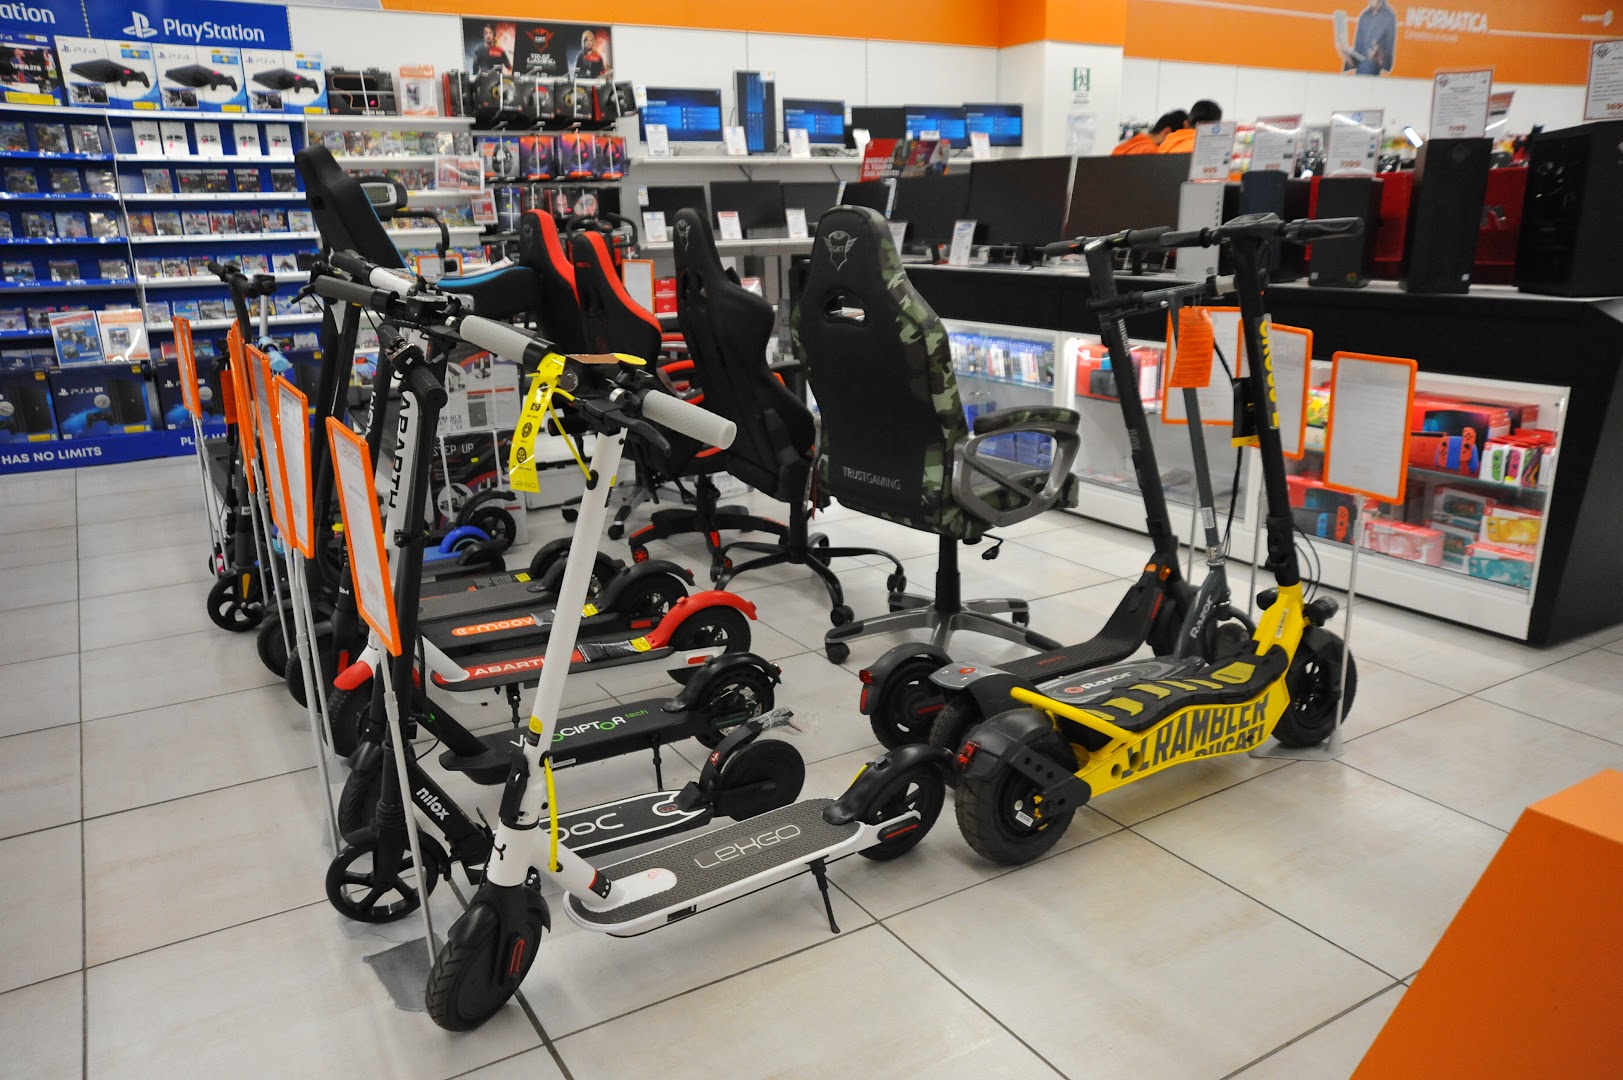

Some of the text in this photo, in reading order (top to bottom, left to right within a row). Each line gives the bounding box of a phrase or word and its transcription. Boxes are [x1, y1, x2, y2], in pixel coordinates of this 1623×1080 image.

[0, 2, 56, 24] ation
[1405, 6, 1489, 33] INFORMATICA
[163, 17, 266, 43] PlayStation
[71, 386, 93, 395] PS4
[1, 446, 103, 465] HAS NO LIMITS
[389, 396, 411, 509] ABARTH
[461, 442, 475, 454] UP
[842, 465, 901, 490] TRUSTGAMING
[1189, 594, 1213, 639] Razor
[1080, 670, 1132, 691] Razor
[624, 708, 649, 719] tech
[415, 787, 451, 822] nilox
